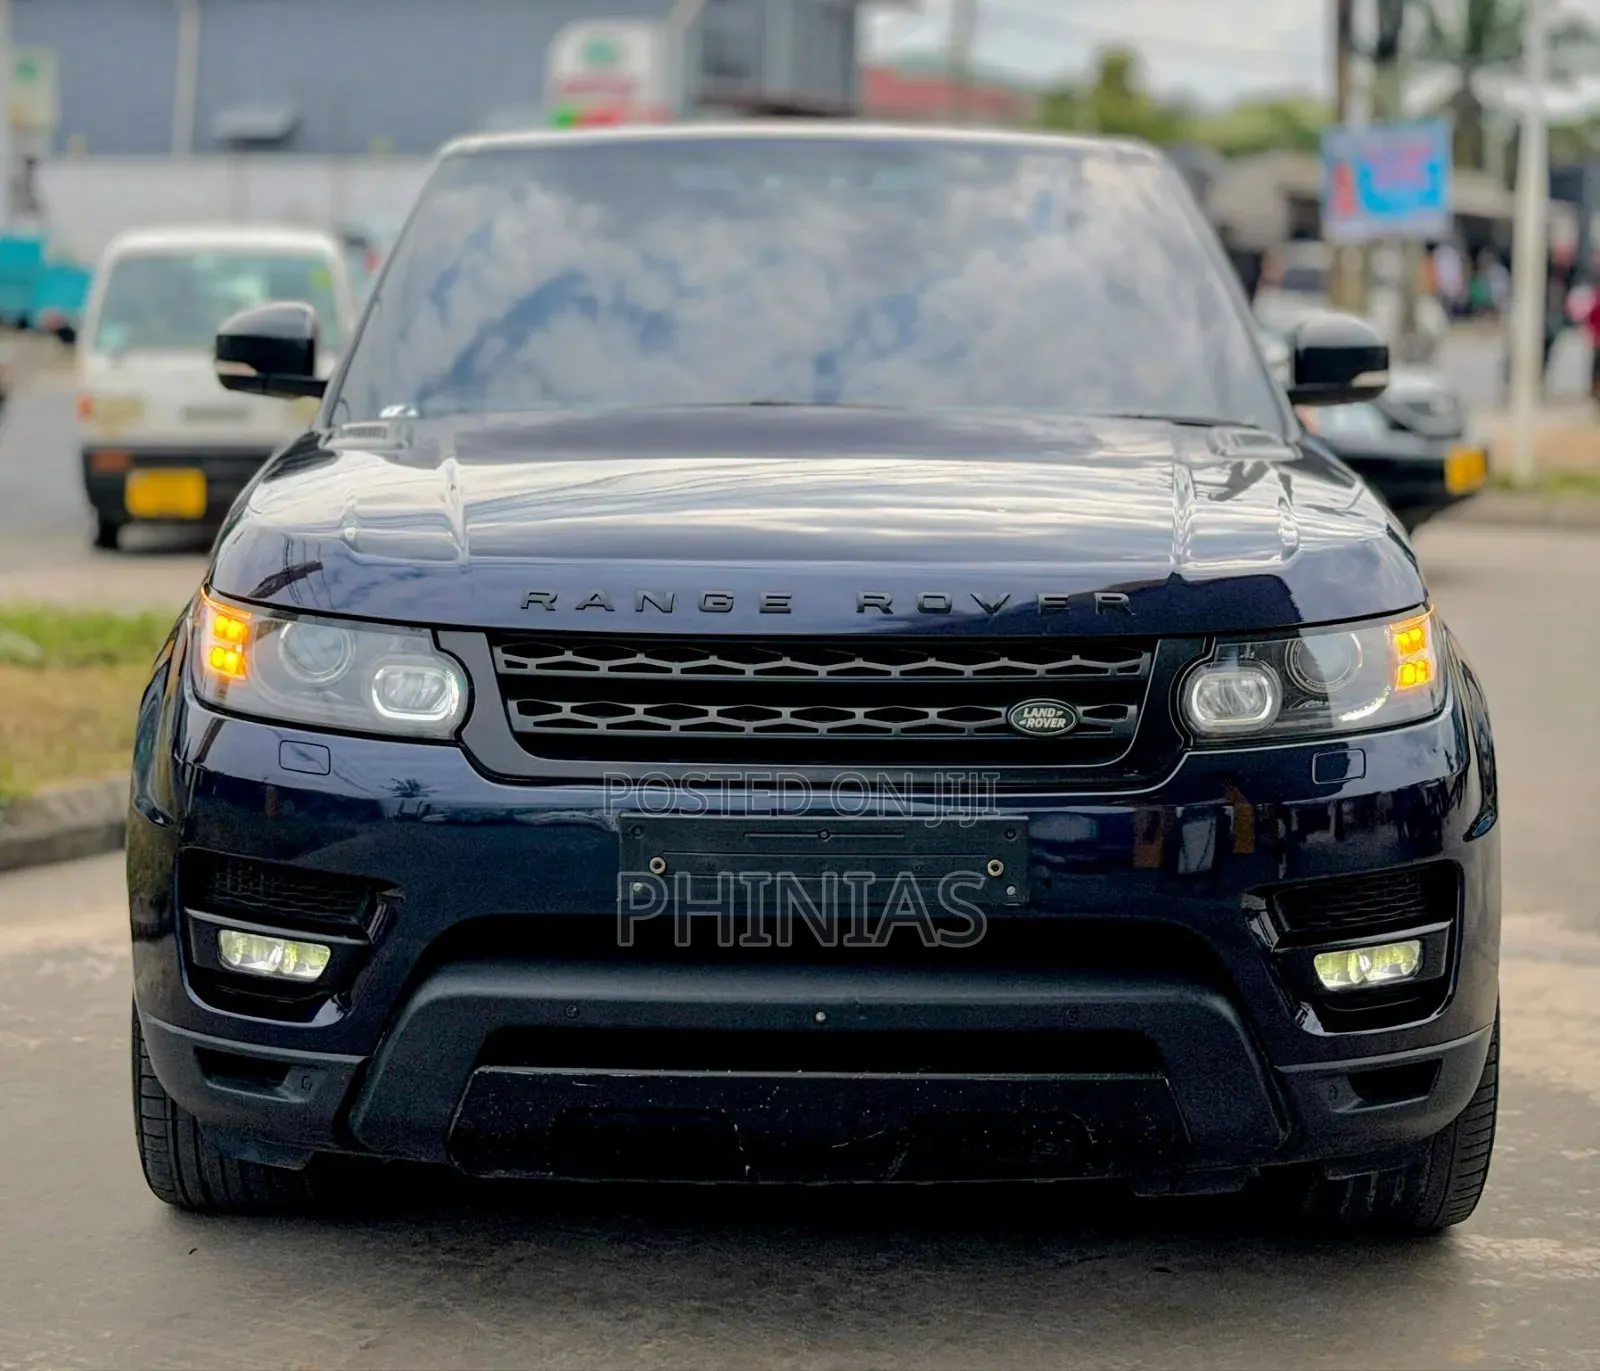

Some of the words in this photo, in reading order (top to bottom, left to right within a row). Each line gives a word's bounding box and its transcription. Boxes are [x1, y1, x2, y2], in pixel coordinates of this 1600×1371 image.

[520, 589, 793, 614] RANGE
[856, 591, 1137, 616] ROVER
[1023, 707, 1056, 717] LAND
[1025, 718, 1066, 728] ROVER
